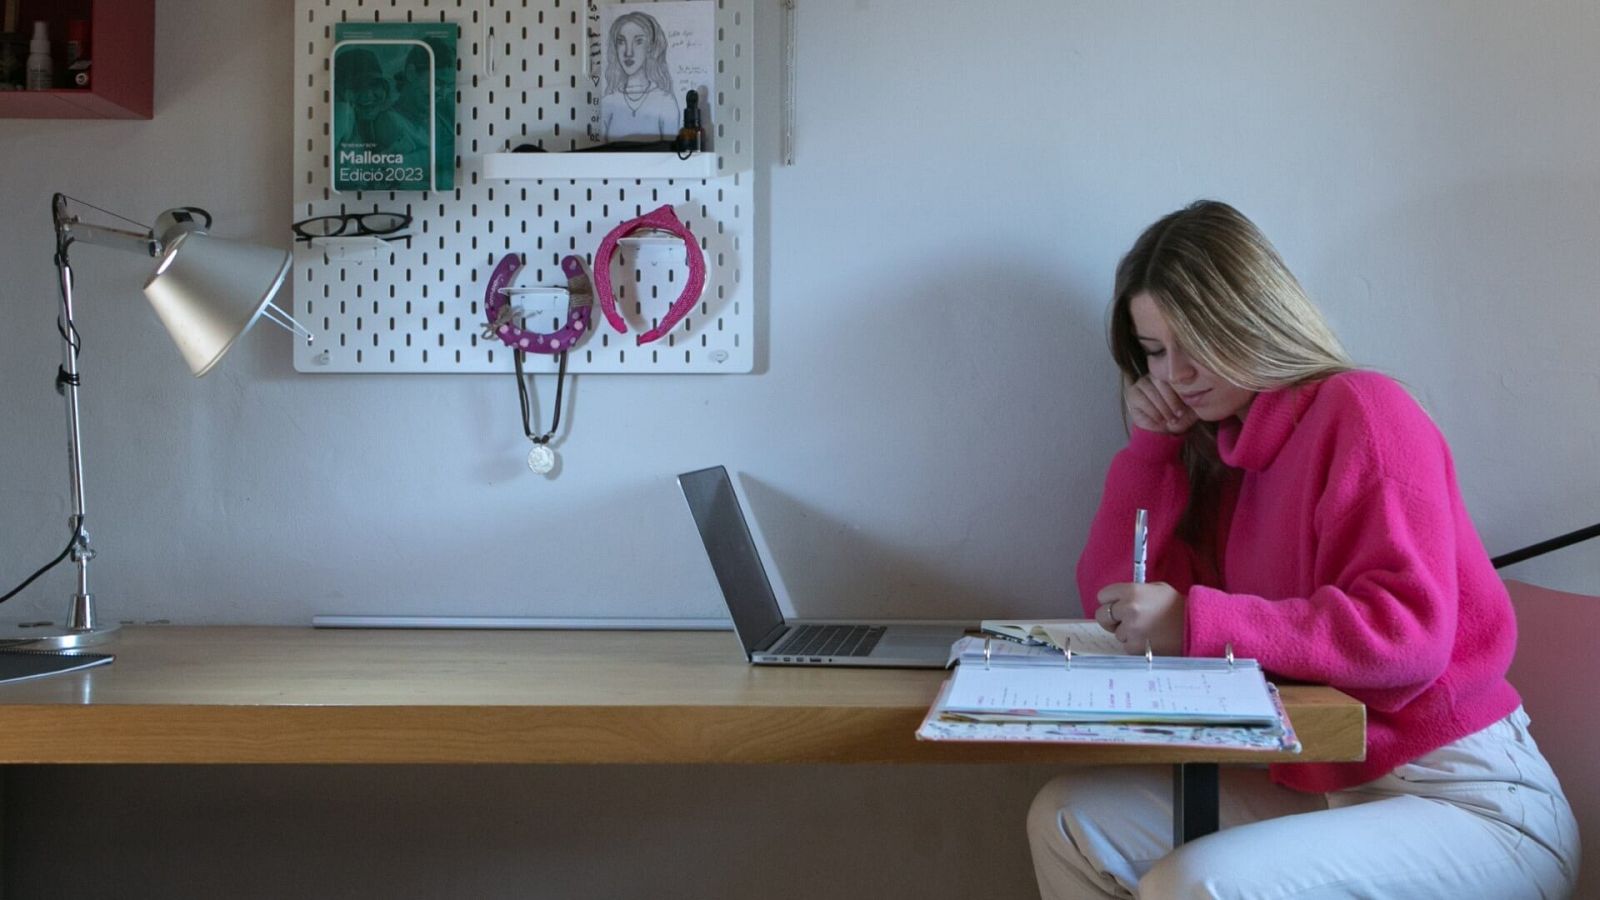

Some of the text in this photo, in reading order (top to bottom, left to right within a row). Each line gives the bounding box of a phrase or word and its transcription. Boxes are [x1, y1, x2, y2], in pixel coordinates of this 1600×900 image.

[340, 151, 404, 164] Mallorca
[340, 167, 423, 181] Edició 2023
